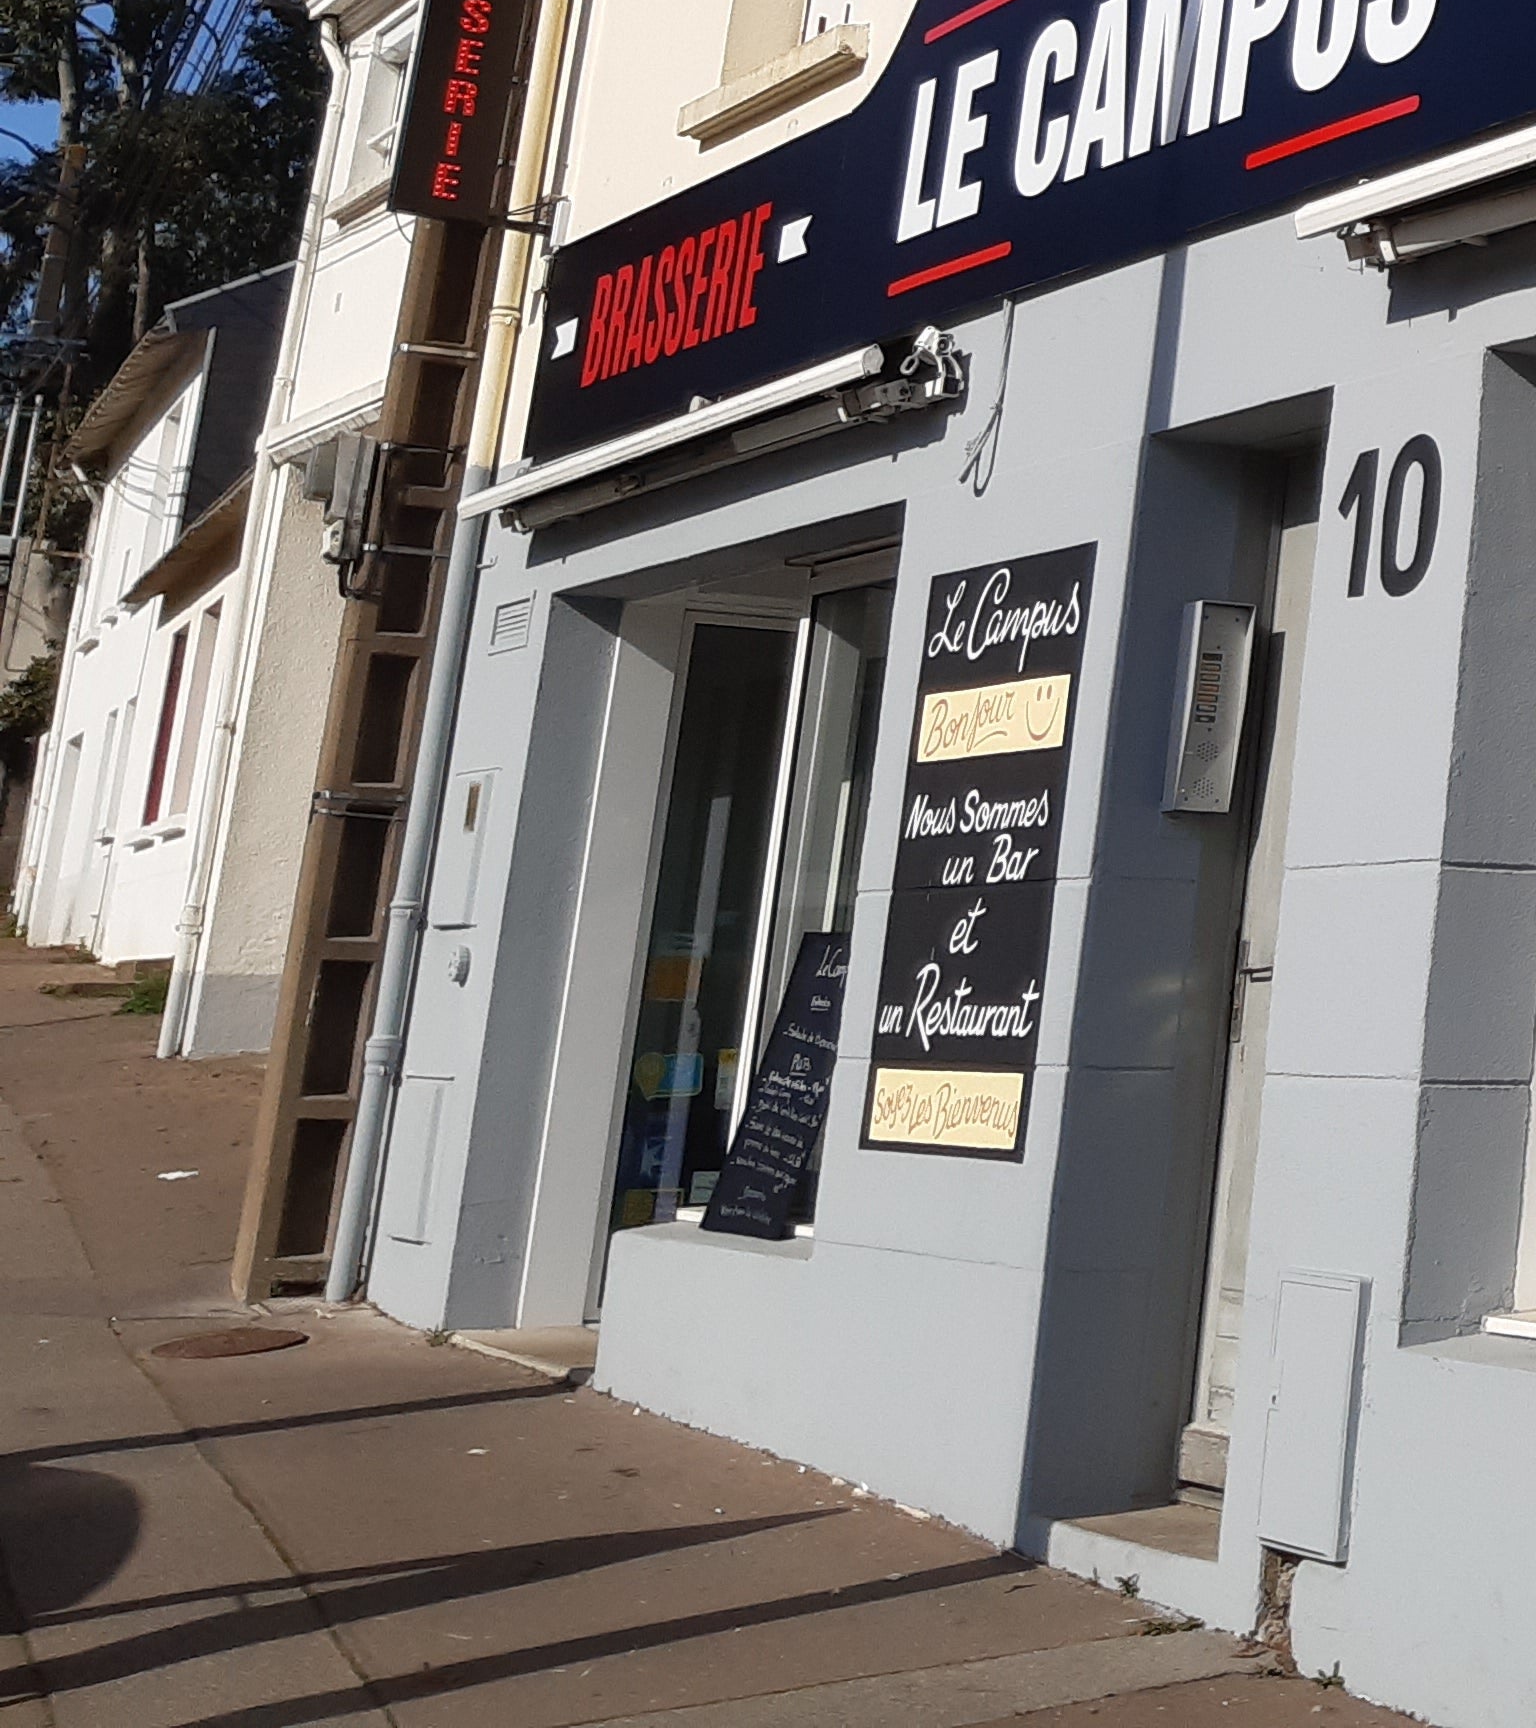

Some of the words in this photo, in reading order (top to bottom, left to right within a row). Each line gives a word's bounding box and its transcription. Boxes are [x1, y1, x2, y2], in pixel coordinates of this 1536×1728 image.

[895, 50, 999, 244] LE
[580, 202, 773, 389] BRASSERIE
[1337, 433, 1442, 601] 10
[928, 579, 967, 658] Le
[967, 567, 1081, 673] Campus
[924, 691, 1015, 758] Bonjour
[905, 794, 957, 841] Nous
[960, 788, 1049, 832] Sommes
[942, 853, 975, 884] un
[986, 833, 1039, 884] Bar
[949, 899, 986, 955] et
[879, 1001, 904, 1037] un
[907, 962, 1041, 1051] Restaurant
[874, 1082, 914, 1129] Soyez
[908, 1093, 933, 1136] Les
[932, 1082, 1019, 1140] Bienvenus
